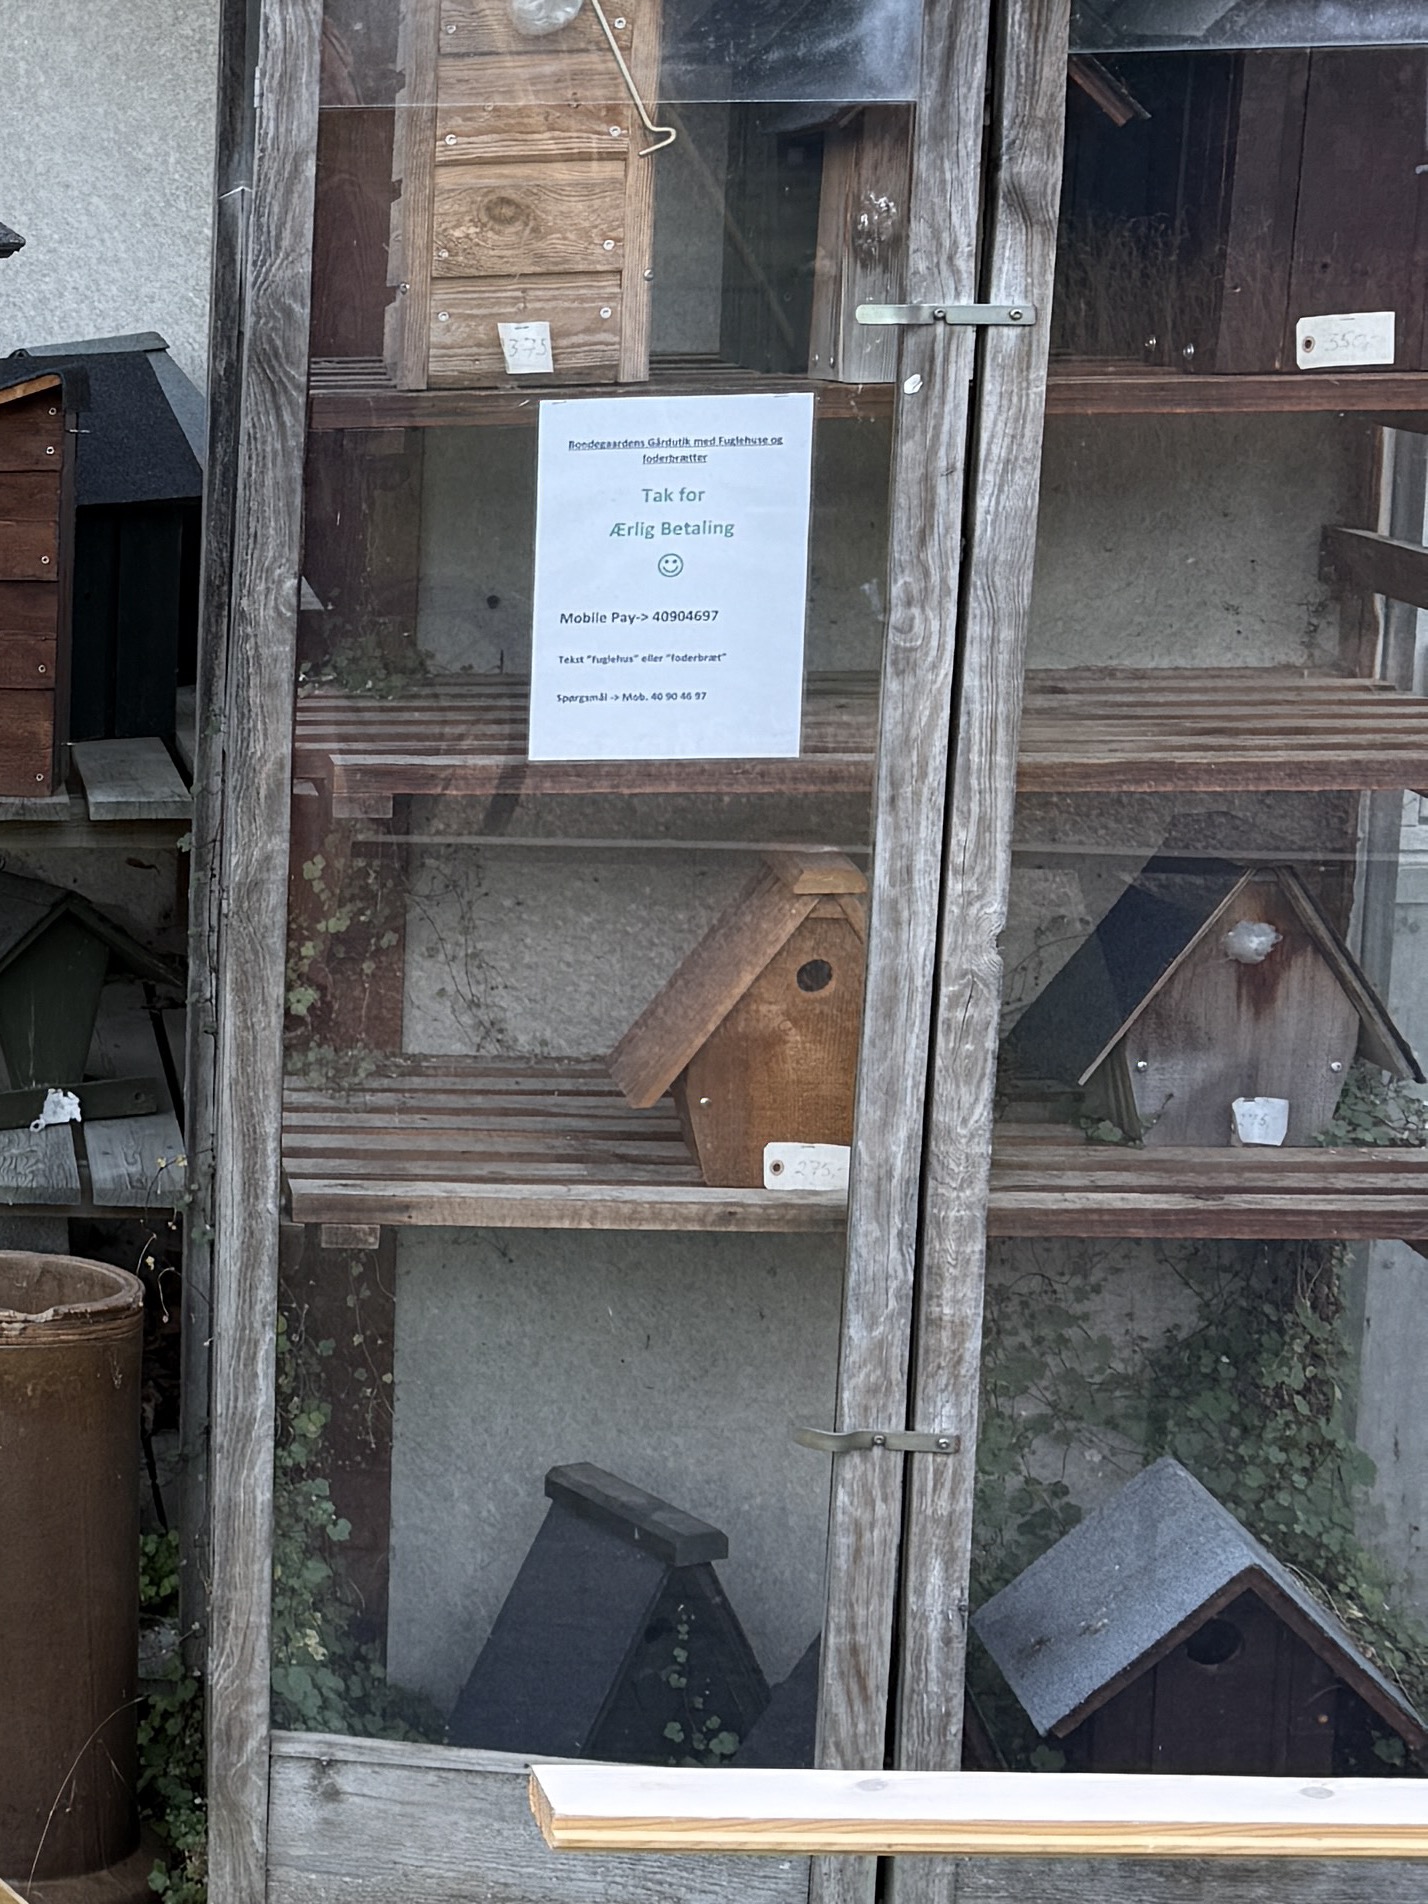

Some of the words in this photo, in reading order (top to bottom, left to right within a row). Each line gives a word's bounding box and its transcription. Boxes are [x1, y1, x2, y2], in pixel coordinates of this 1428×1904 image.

[508, 336, 548, 359] 375
[694, 436, 716, 446] med
[719, 436, 768, 446] Fuglehuse
[771, 436, 783, 445] og
[642, 488, 674, 502] Tak
[679, 487, 705, 502] for
[609, 521, 655, 539] Ærlig
[661, 520, 735, 537] Betaling
[560, 612, 607, 624] Mobile
[652, 610, 719, 622] 40904697
[559, 655, 584, 664] Tekst
[641, 654, 663, 663] eller
[556, 693, 608, 704] Spørgsmål
[622, 693, 648, 702] Mob.
[651, 693, 663, 701] 40
[665, 693, 678, 701] 90
[680, 692, 692, 701] 46
[695, 692, 707, 701] 97
